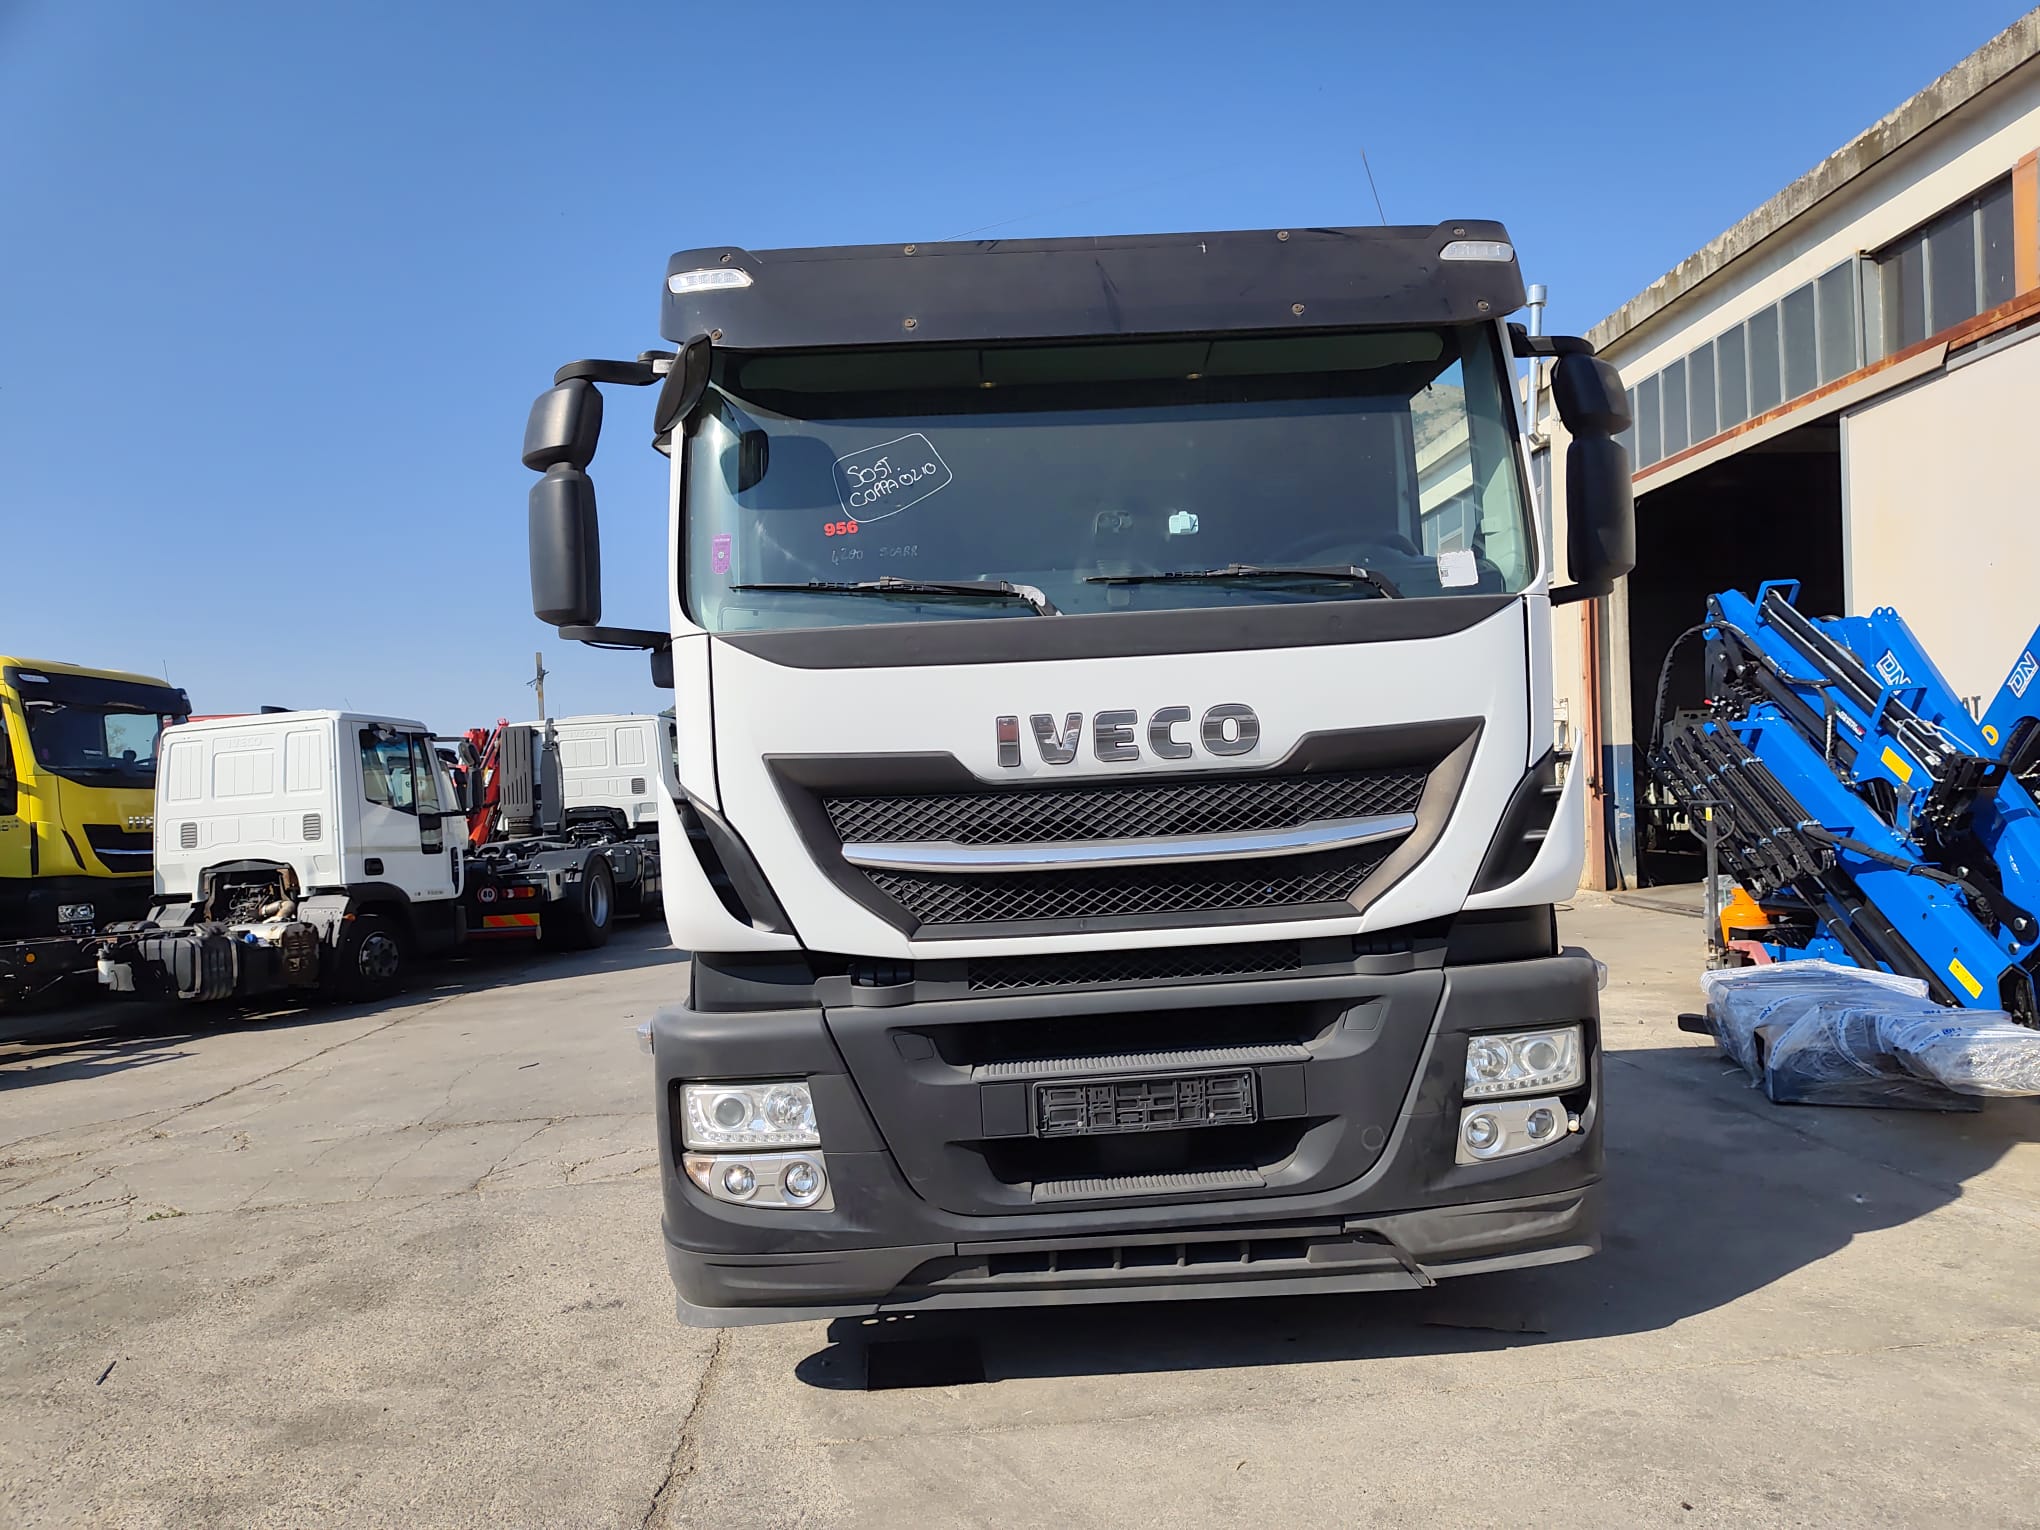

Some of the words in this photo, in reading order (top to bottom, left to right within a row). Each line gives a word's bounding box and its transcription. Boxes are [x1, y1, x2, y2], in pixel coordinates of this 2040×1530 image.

[849, 479, 899, 507] COPPA
[823, 520, 859, 537] 956
[2007, 651, 2039, 698] DN
[996, 703, 1260, 767] IVECO
